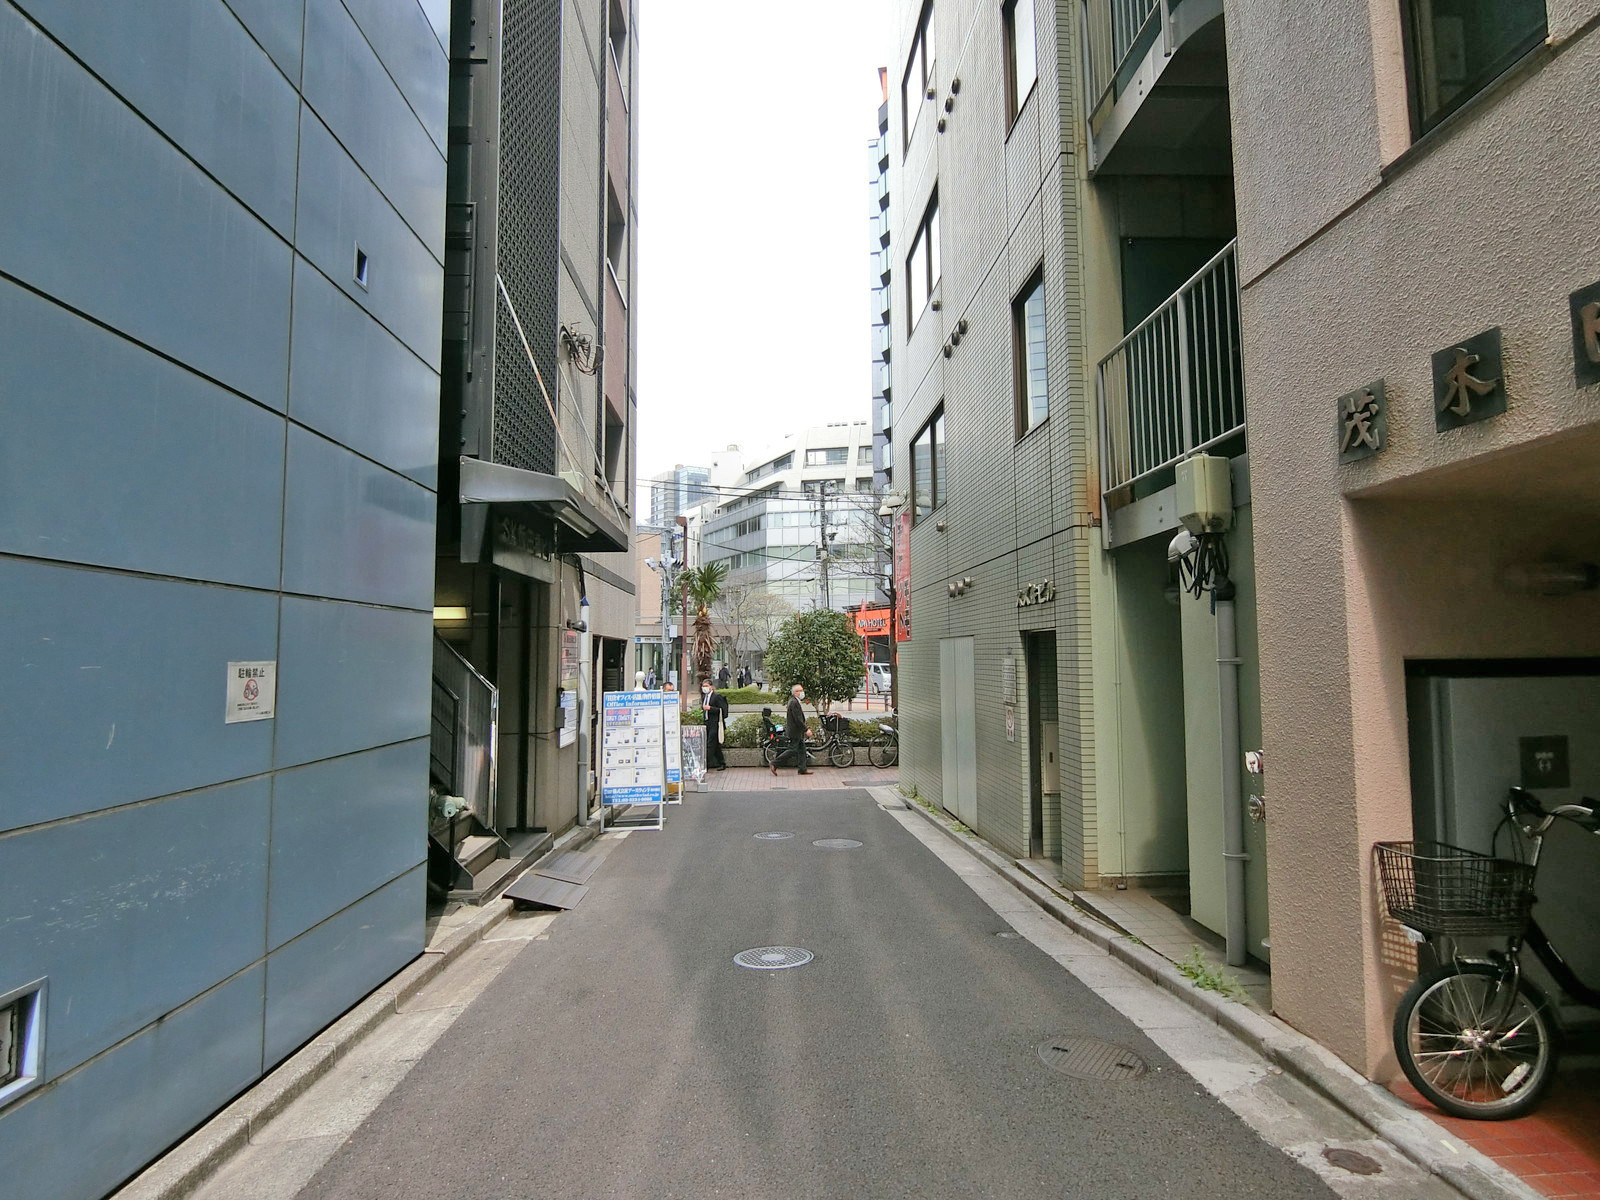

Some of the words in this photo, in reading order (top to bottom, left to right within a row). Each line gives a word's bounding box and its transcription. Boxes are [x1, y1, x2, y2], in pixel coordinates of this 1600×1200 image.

[868, 618, 887, 627] HOTEL
[238, 667, 265, 679] 駐輪禁止
